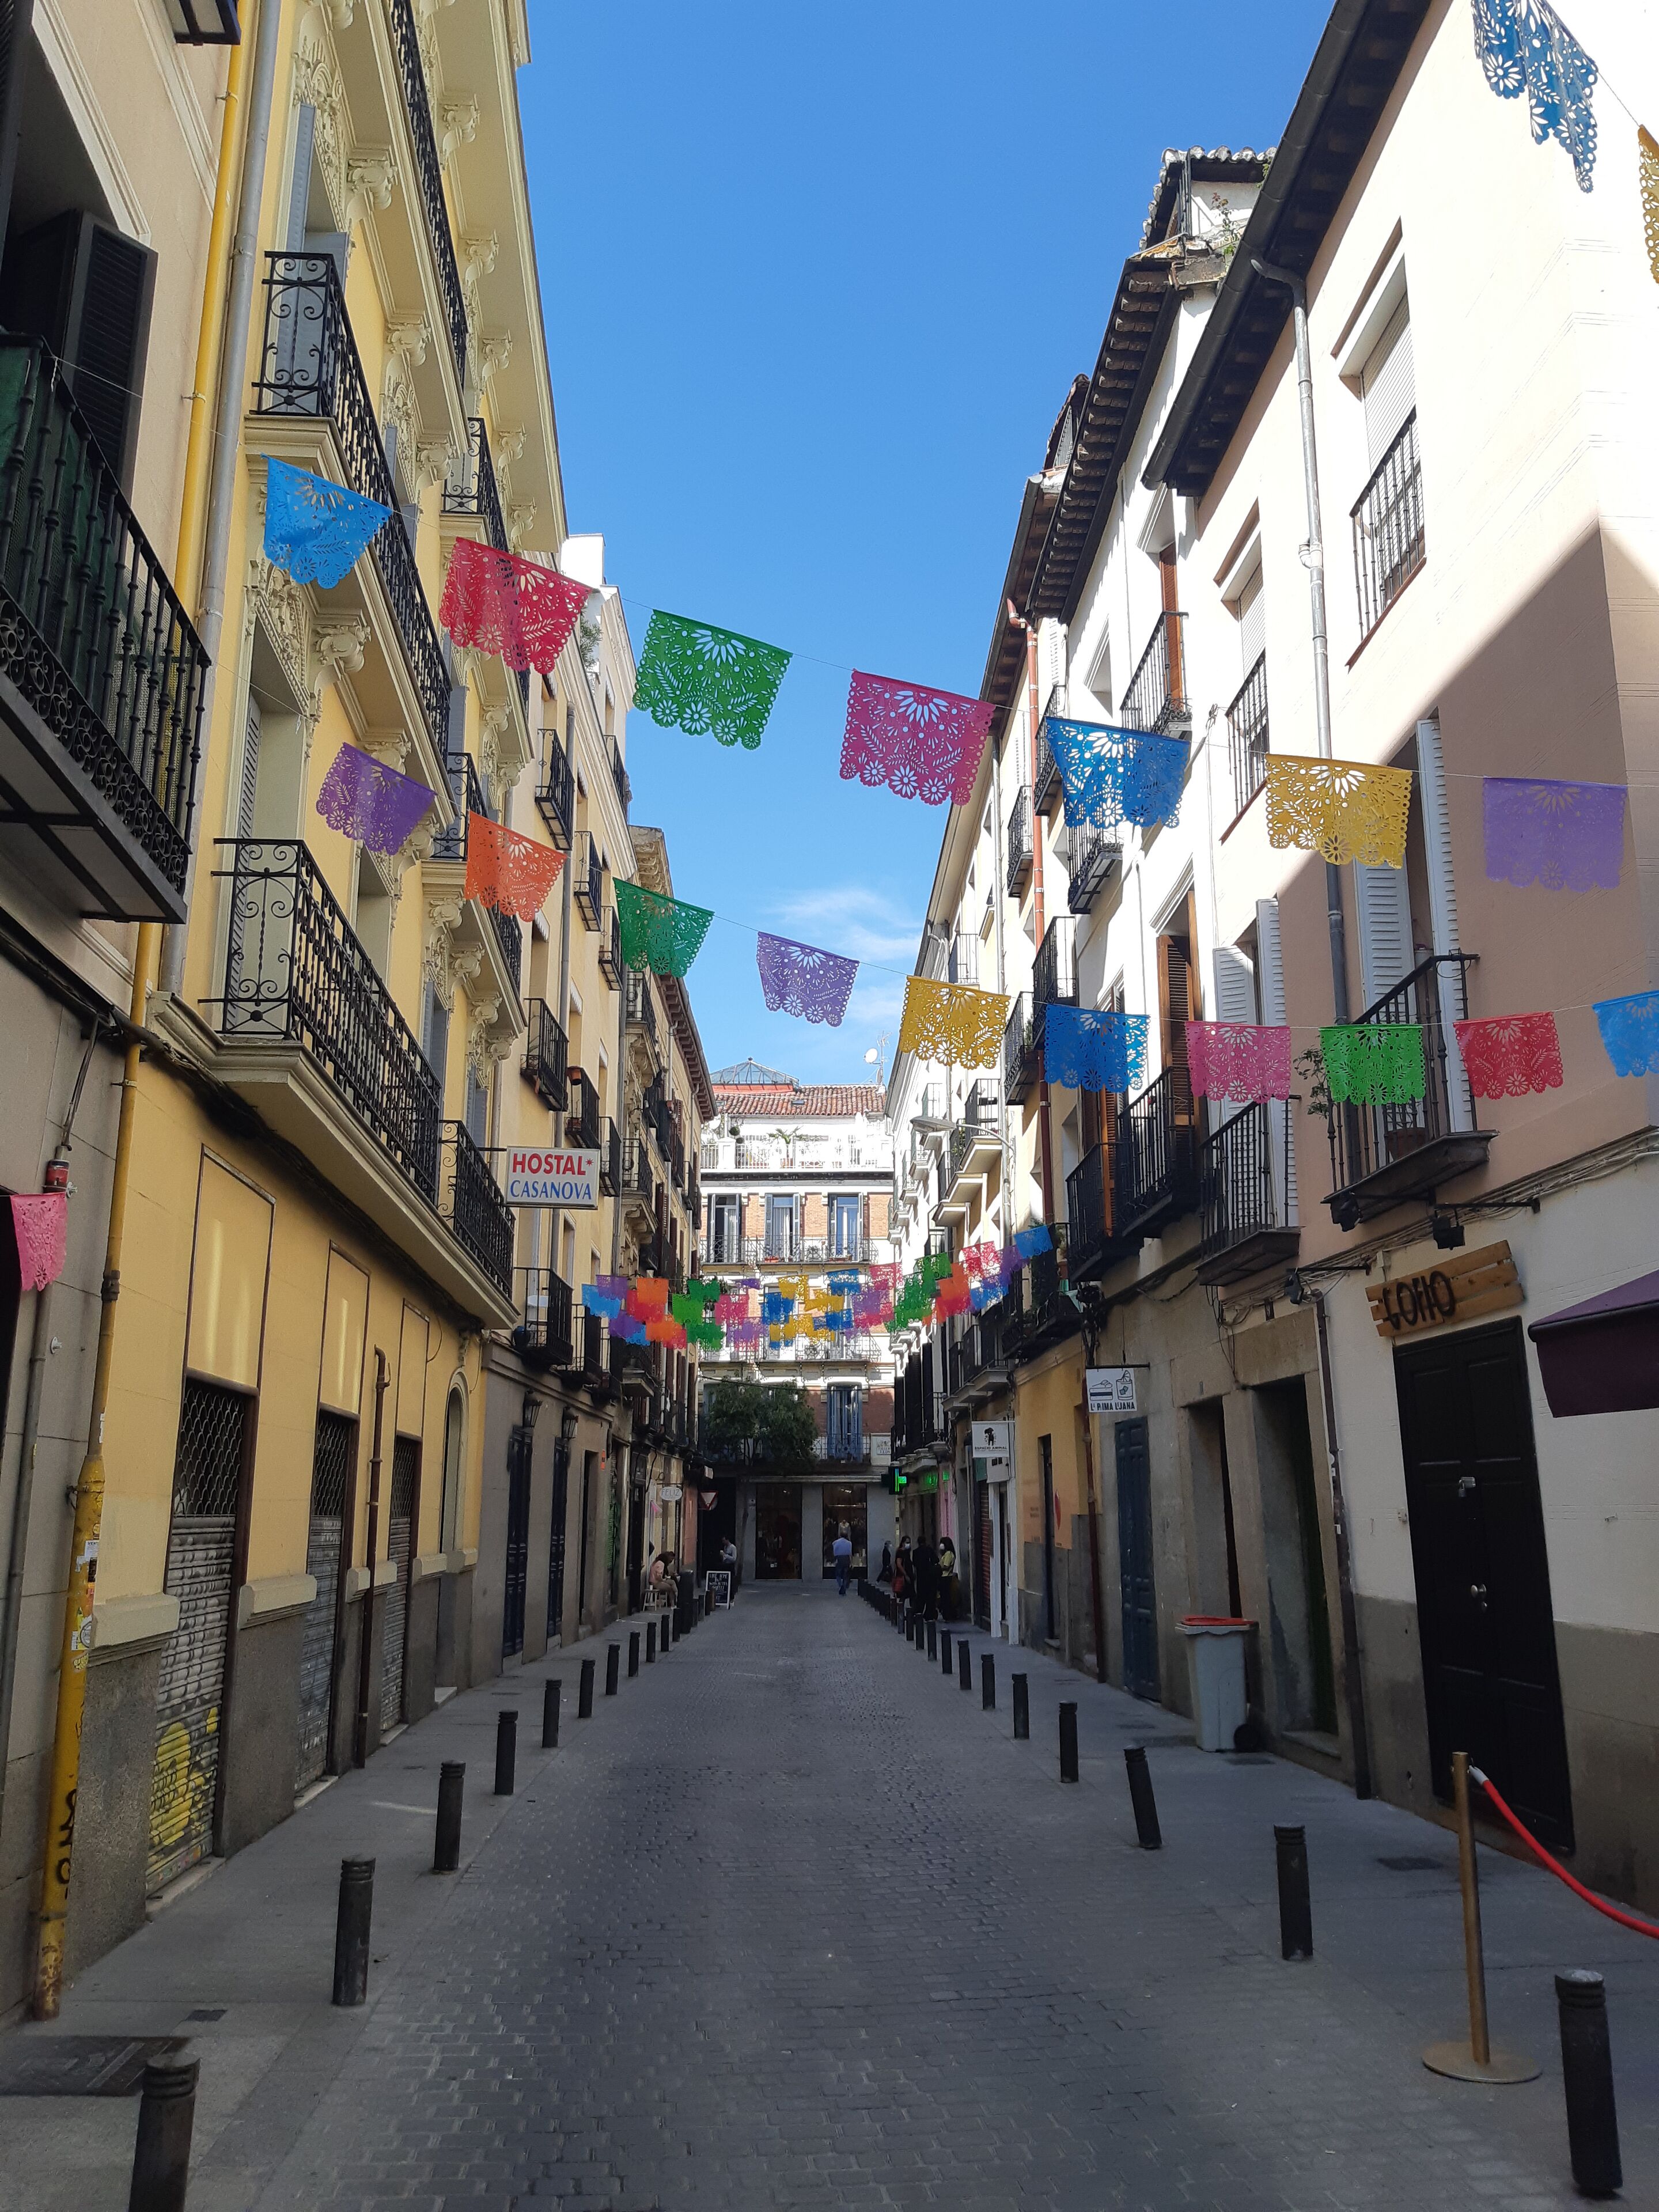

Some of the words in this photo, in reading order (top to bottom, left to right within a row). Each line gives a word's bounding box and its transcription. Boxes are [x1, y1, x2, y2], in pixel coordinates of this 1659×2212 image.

[512, 1153, 586, 1175] HOSTAL
[510, 1180, 592, 1200] CASANOVA
[661, 1488, 680, 1497] FELIZ
